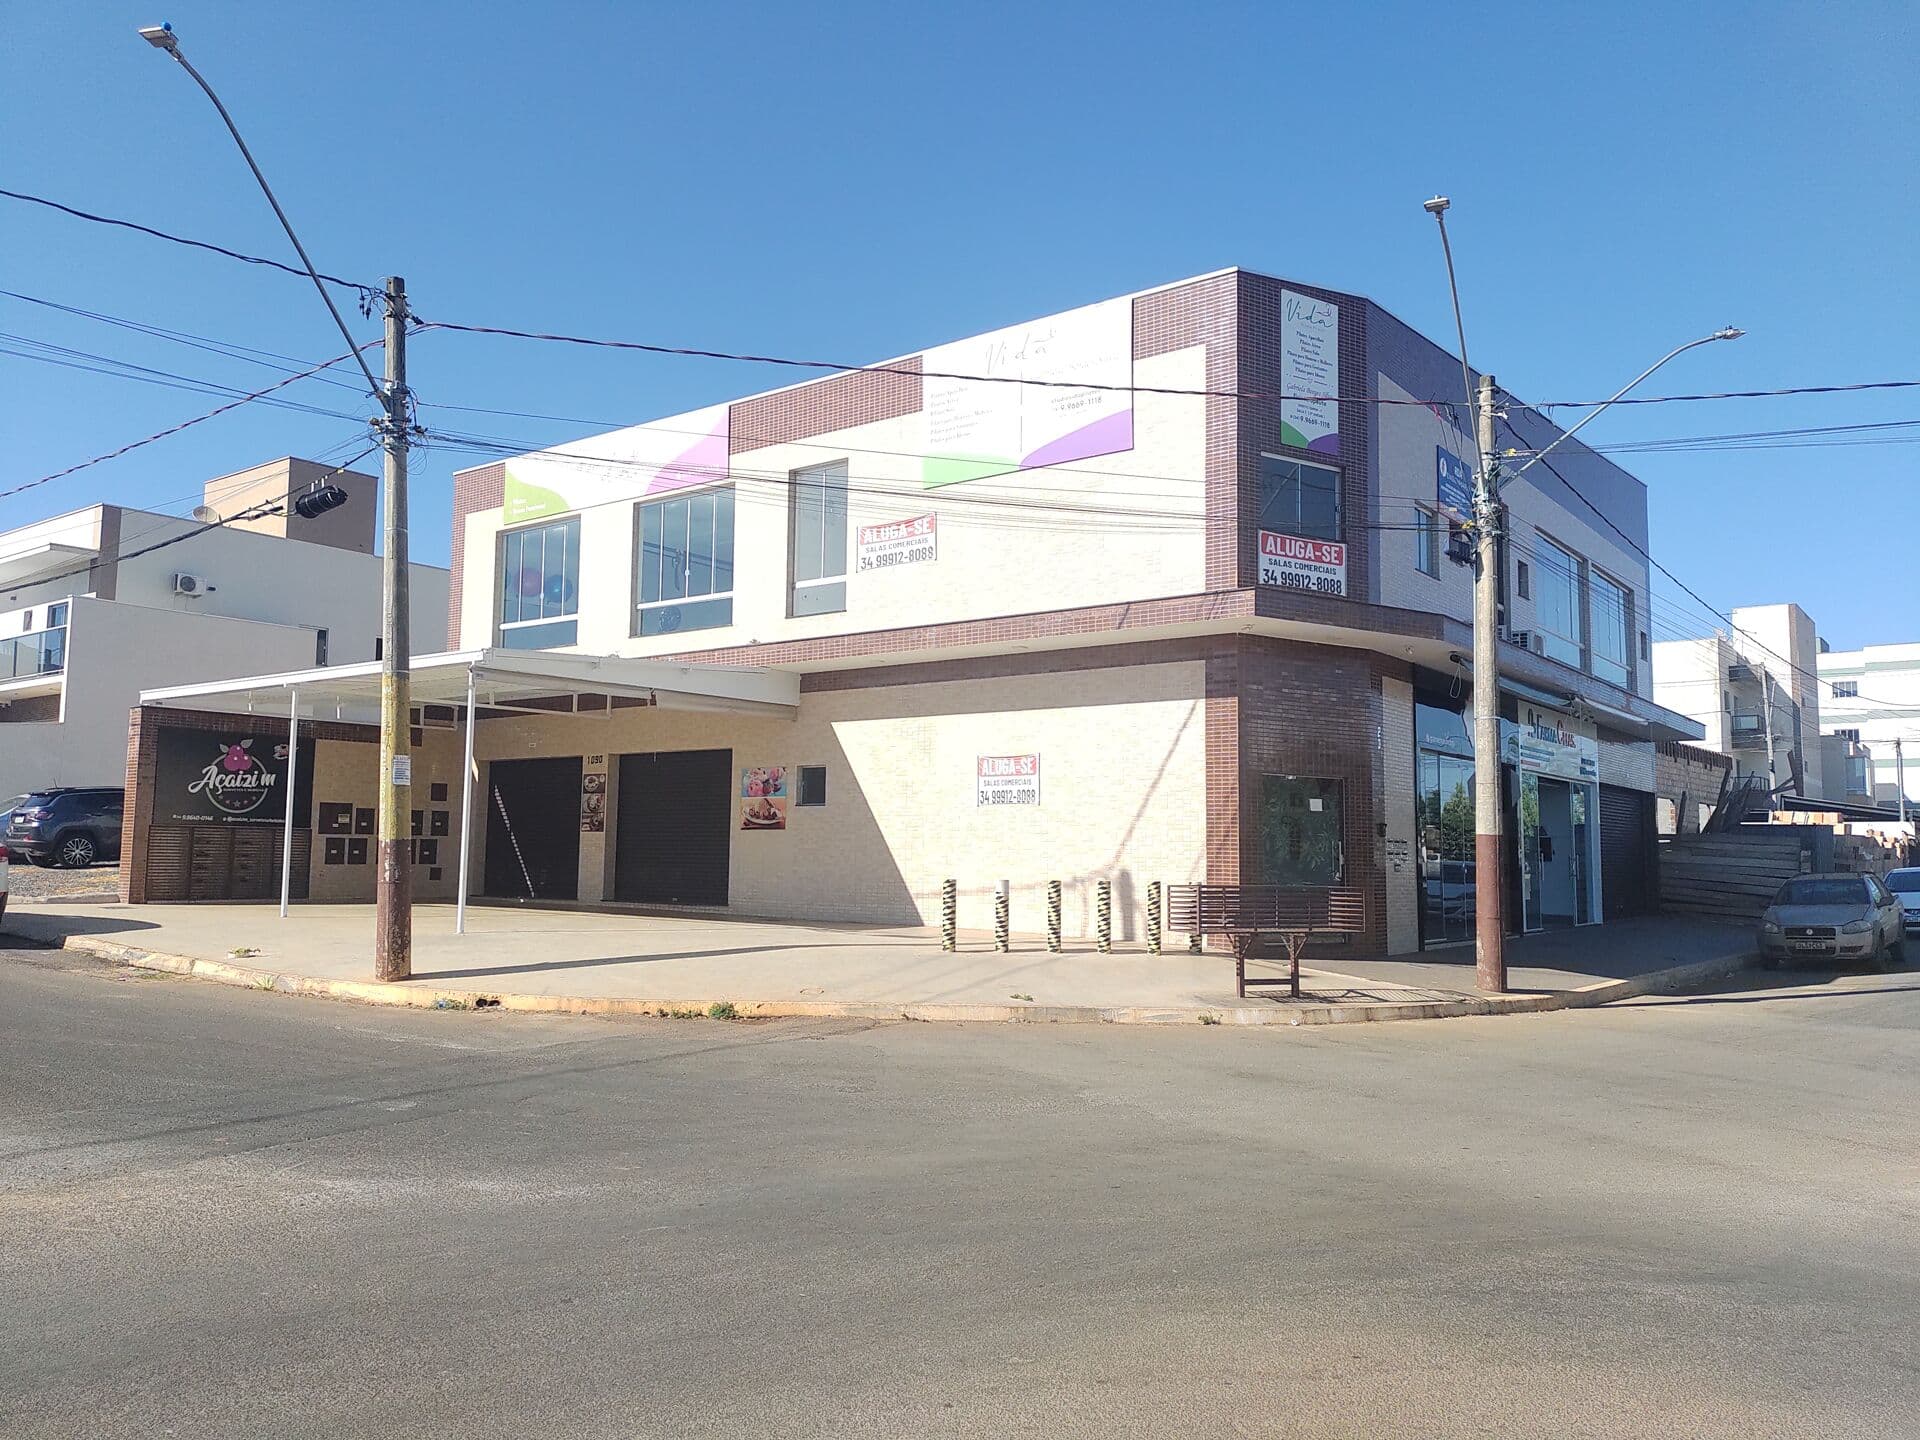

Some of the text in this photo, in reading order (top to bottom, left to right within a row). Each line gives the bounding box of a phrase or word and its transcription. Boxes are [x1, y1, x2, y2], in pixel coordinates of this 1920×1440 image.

[1286, 297, 1334, 328] Vida
[862, 516, 931, 544] ALUGA-SE
[860, 546, 934, 570] 34 99912-8088
[865, 544, 887, 554] SALAS
[1265, 535, 1340, 564] ALUGA-SE
[1268, 558, 1337, 576] SALAS COMERCIAIS
[1262, 568, 1342, 594] 34 99912-8088
[982, 757, 1035, 776] ALUGA-SE
[979, 789, 1036, 804] 34 99912-8088
